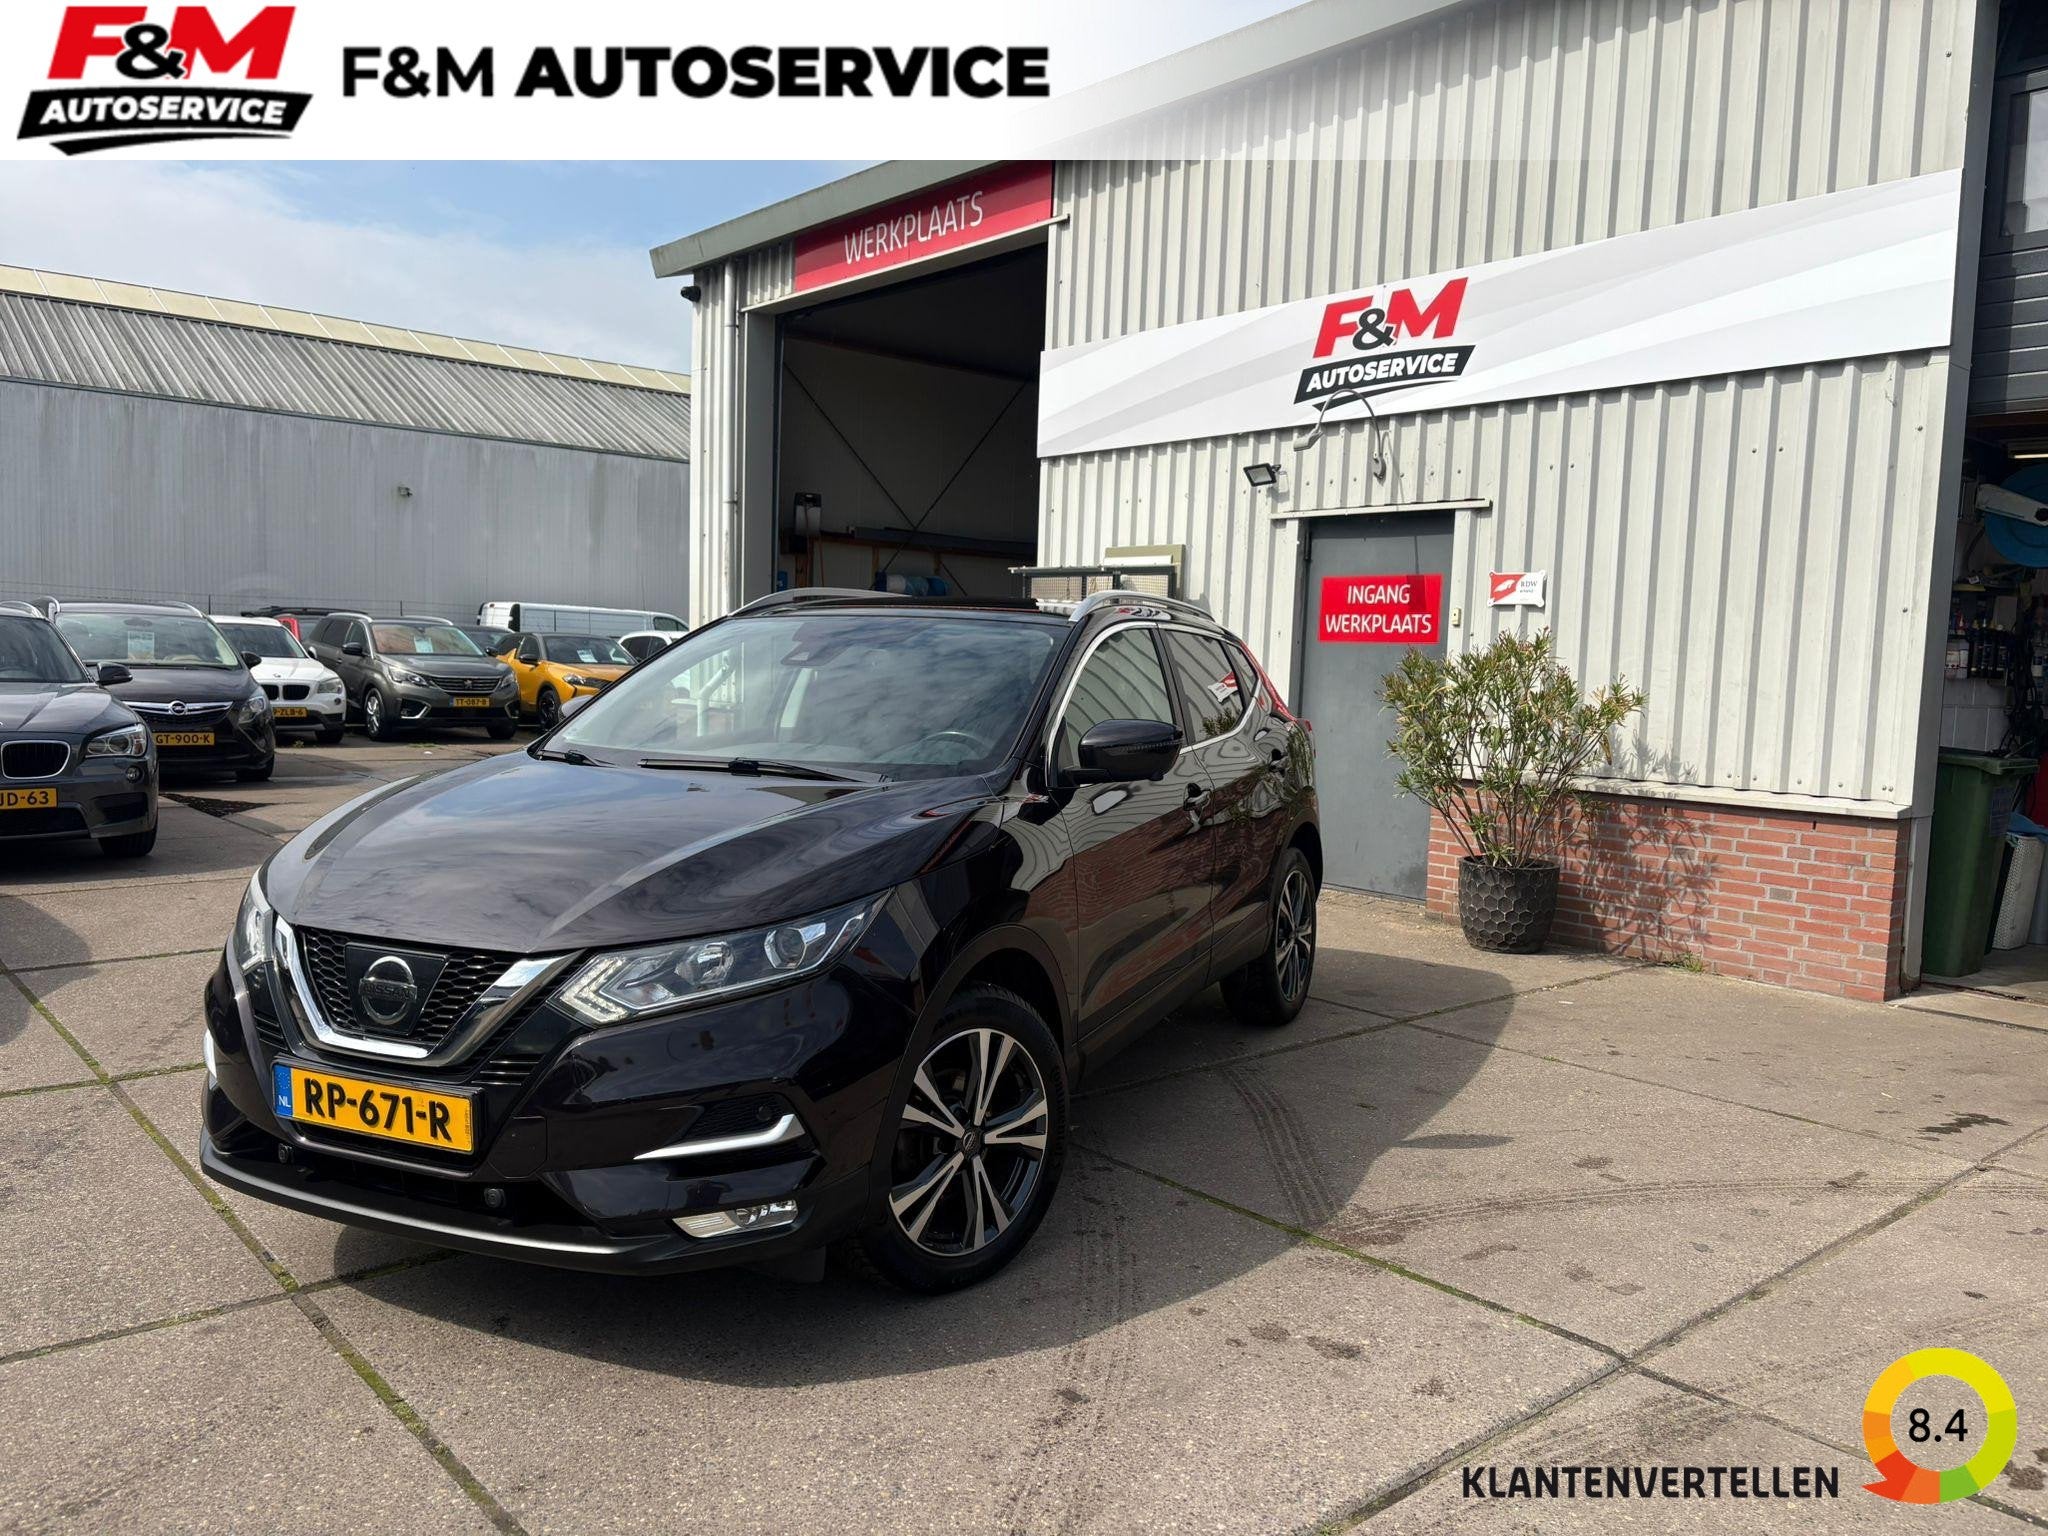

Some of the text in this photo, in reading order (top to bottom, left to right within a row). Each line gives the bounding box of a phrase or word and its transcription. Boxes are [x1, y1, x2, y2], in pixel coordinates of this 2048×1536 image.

[844, 190, 983, 264] WERKPLAATS
[1313, 276, 1469, 358] F&M
[1306, 352, 1458, 392] AUTOSERVICE
[1347, 584, 1411, 604] INGANG
[1325, 613, 1432, 634] WERKPLAATS
[155, 733, 210, 744] GT-900-K
[278, 1095, 291, 1108] NL
[304, 1076, 452, 1142] RP-671-R
